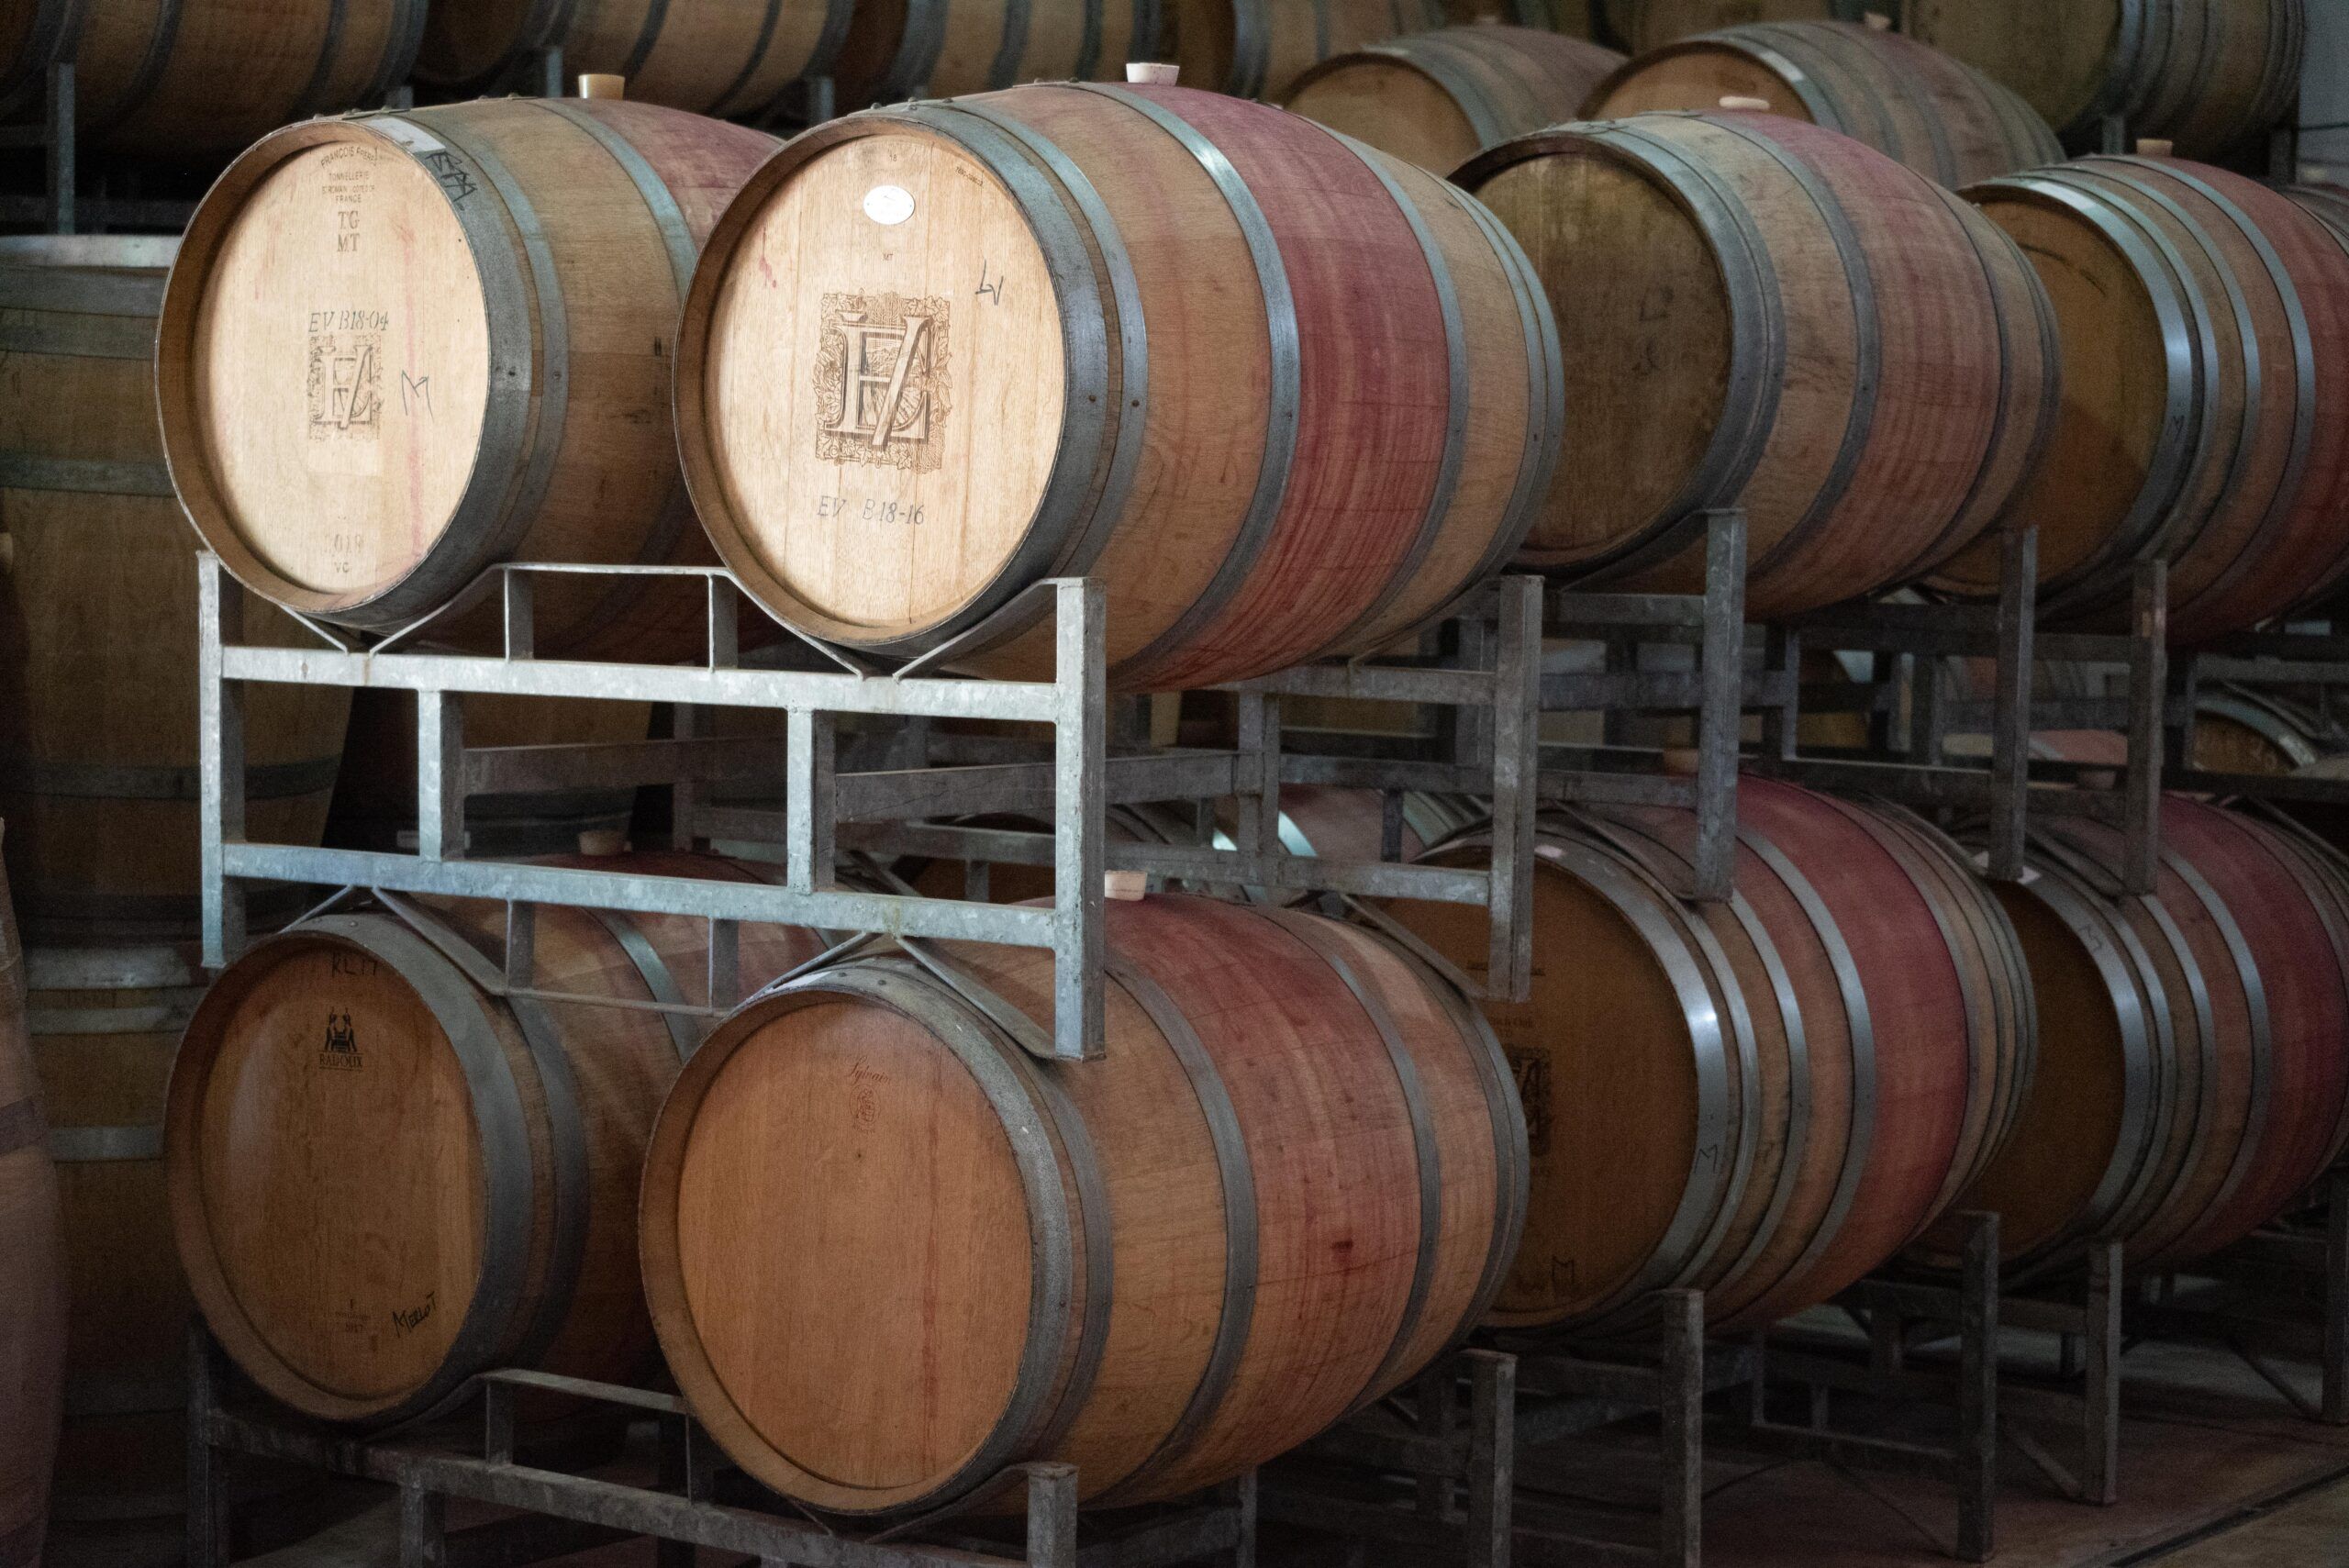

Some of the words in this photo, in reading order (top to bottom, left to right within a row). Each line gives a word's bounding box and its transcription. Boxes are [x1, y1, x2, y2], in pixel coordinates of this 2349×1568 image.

[335, 194, 362, 204] FRANCE
[317, 1053, 363, 1070] RADOUX
[844, 1054, 892, 1086] Sylvain
